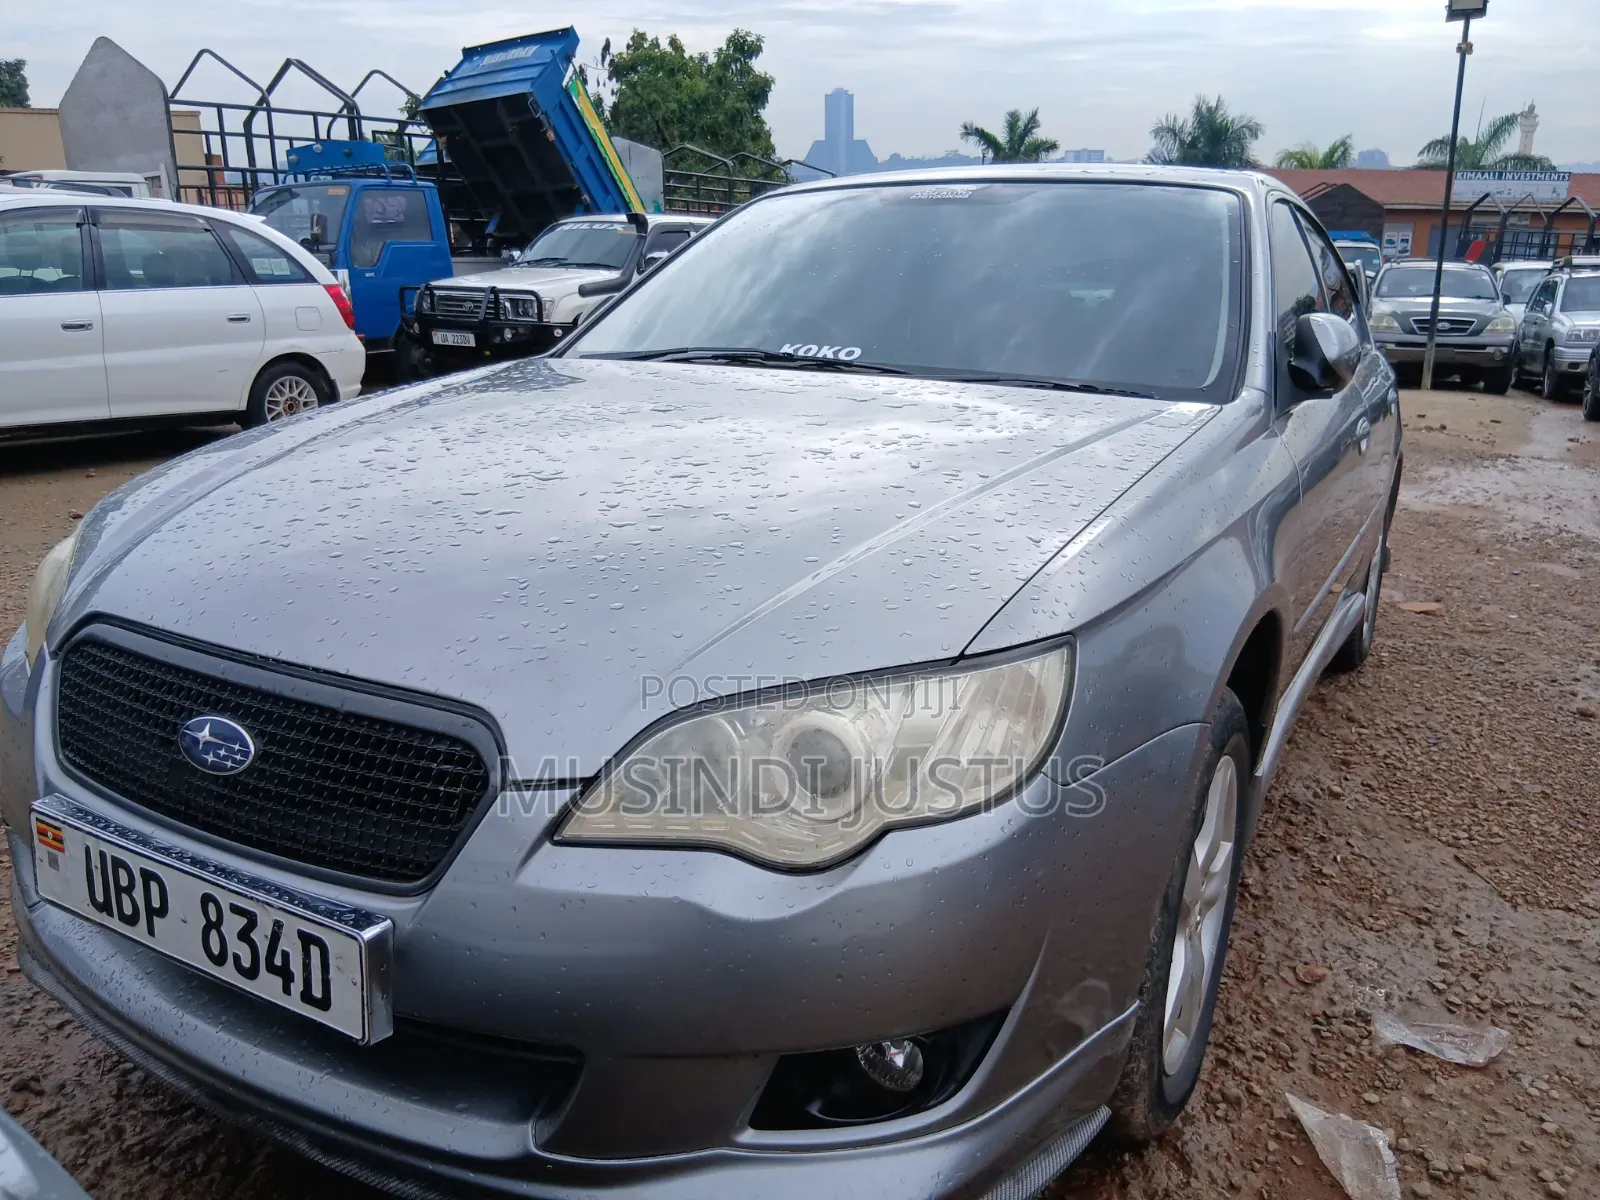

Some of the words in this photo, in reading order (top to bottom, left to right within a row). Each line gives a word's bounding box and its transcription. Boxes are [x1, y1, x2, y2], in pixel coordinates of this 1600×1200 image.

[1456, 171, 1498, 180] KIMAALI
[1502, 172, 1569, 181] INVESTMENTS
[779, 343, 862, 361] KOKO
[84, 842, 169, 938] UBP
[200, 891, 333, 1012] 834D
